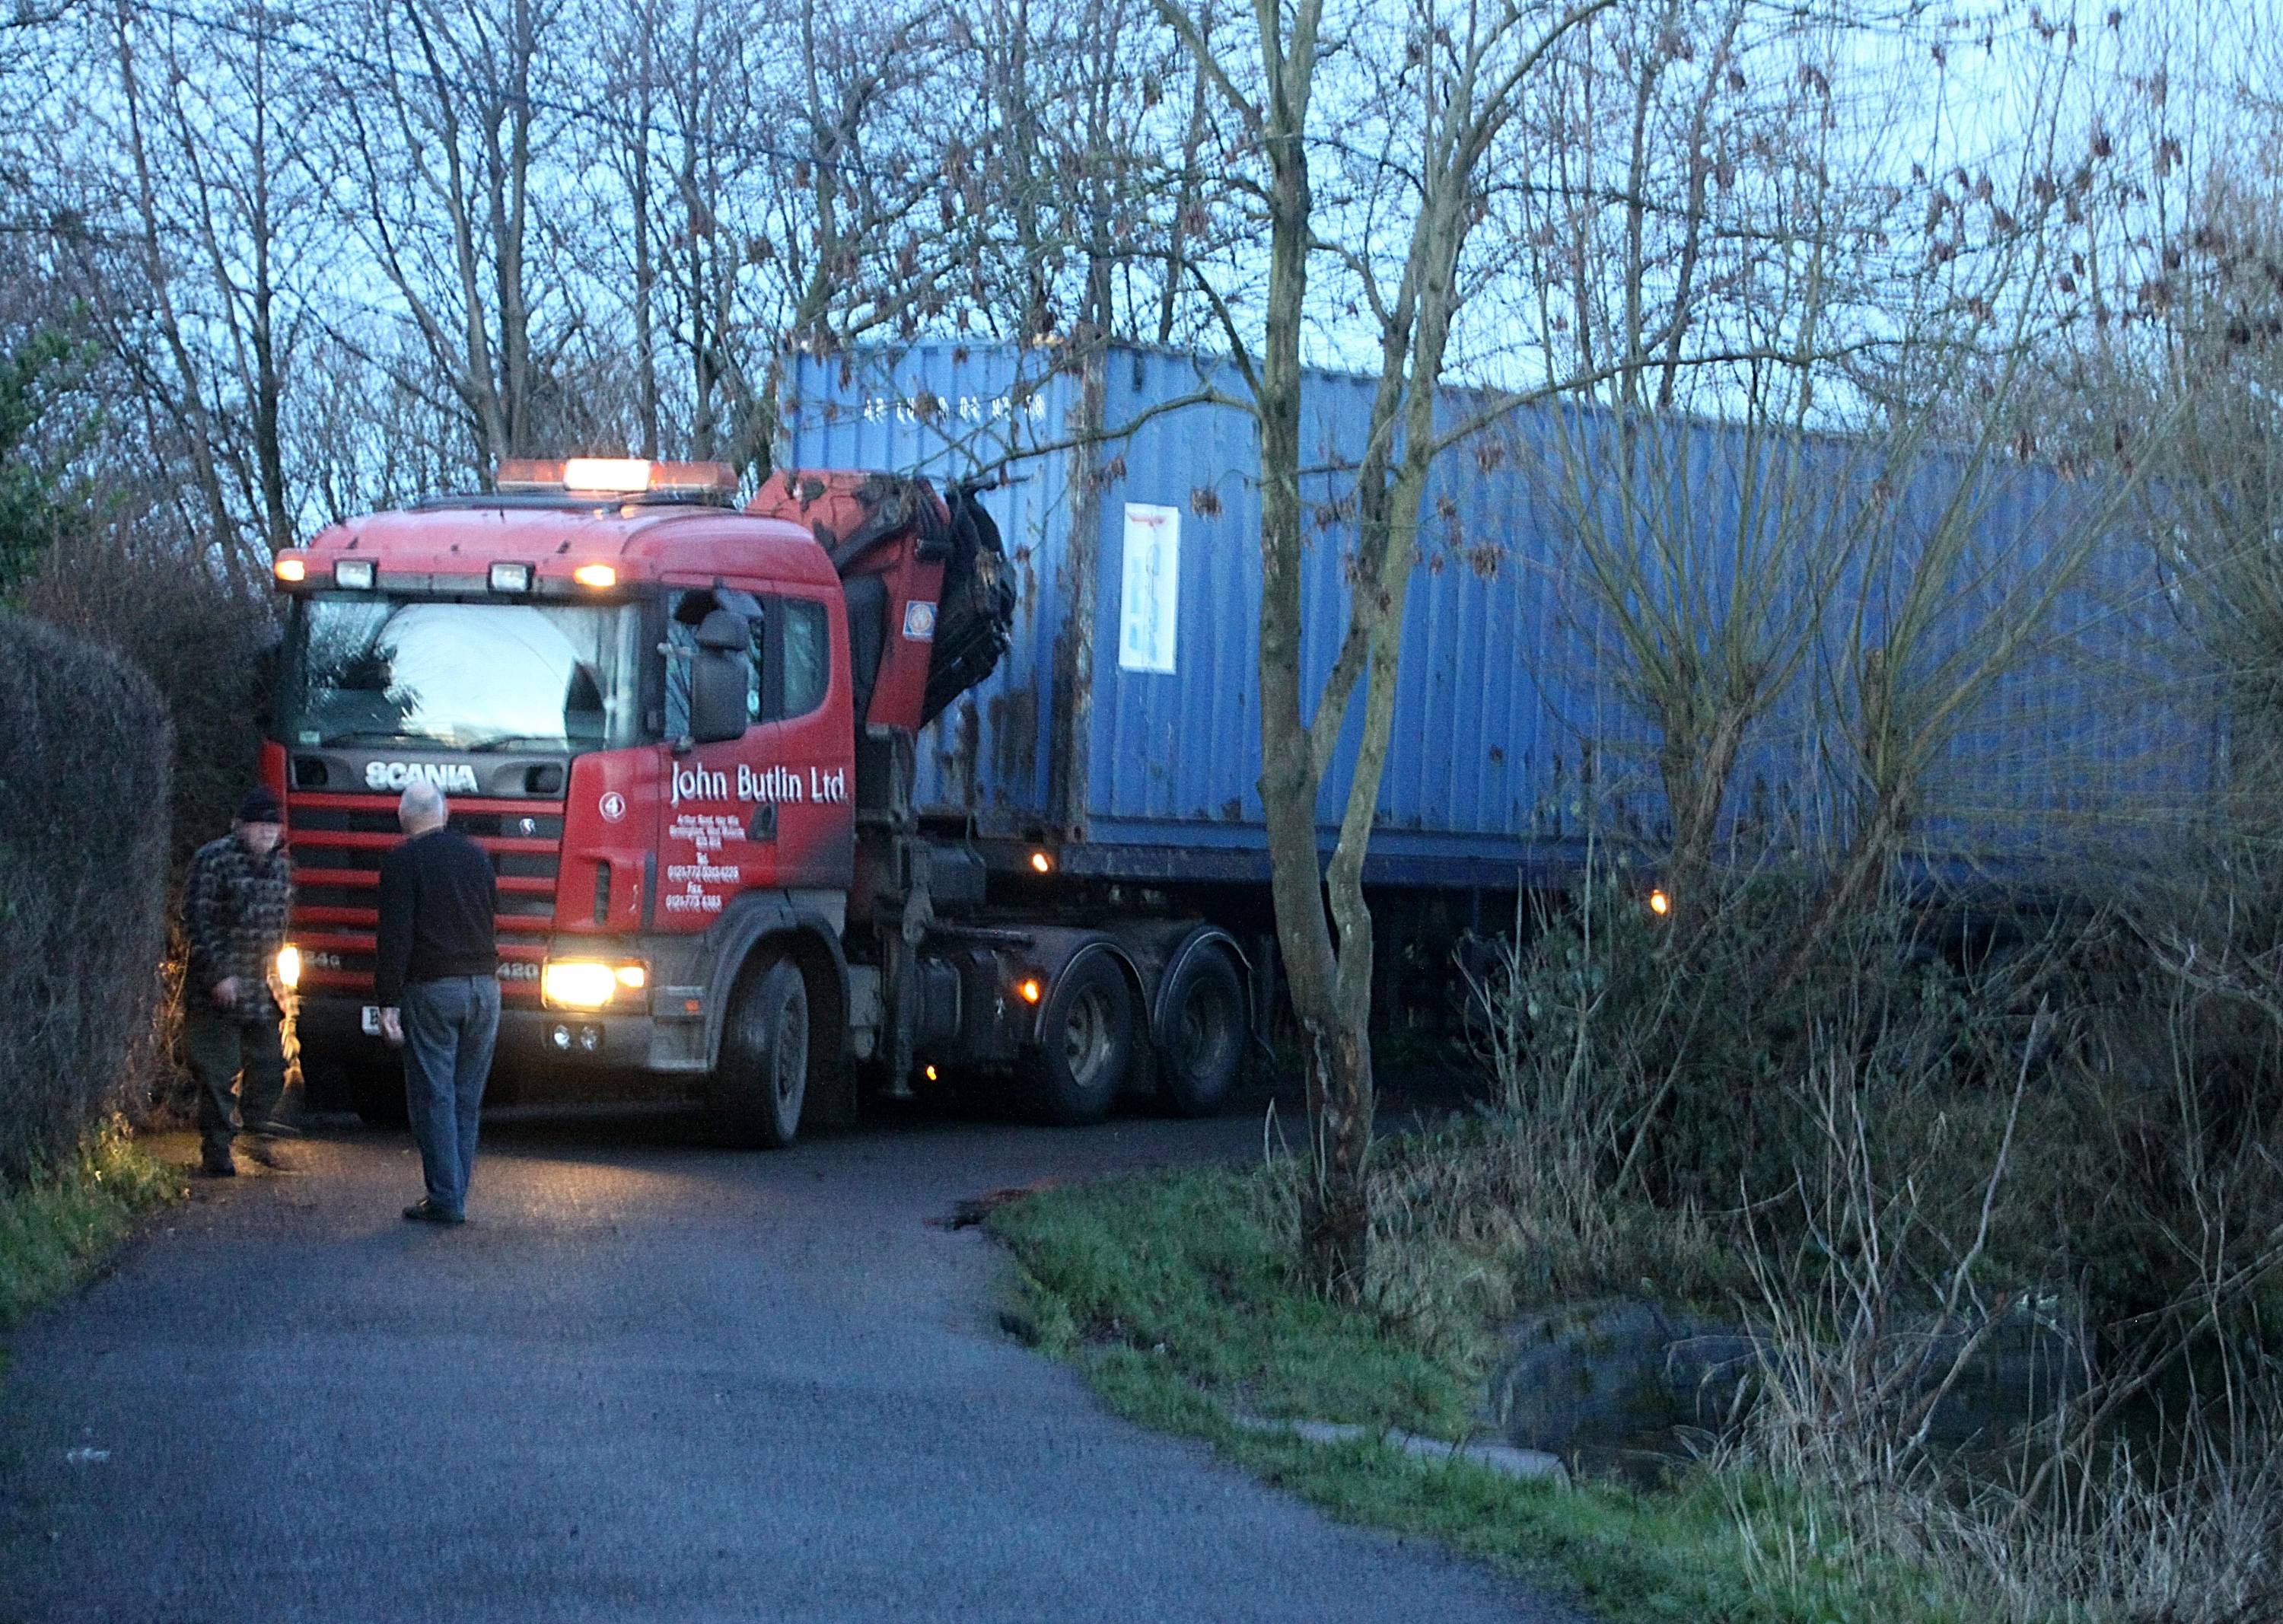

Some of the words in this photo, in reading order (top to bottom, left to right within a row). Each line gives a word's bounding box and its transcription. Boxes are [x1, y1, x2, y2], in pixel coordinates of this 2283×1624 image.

[365, 761, 479, 793] SCANIA
[670, 760, 728, 808] John
[737, 763, 802, 803] Butlin
[495, 962, 540, 981] 420
